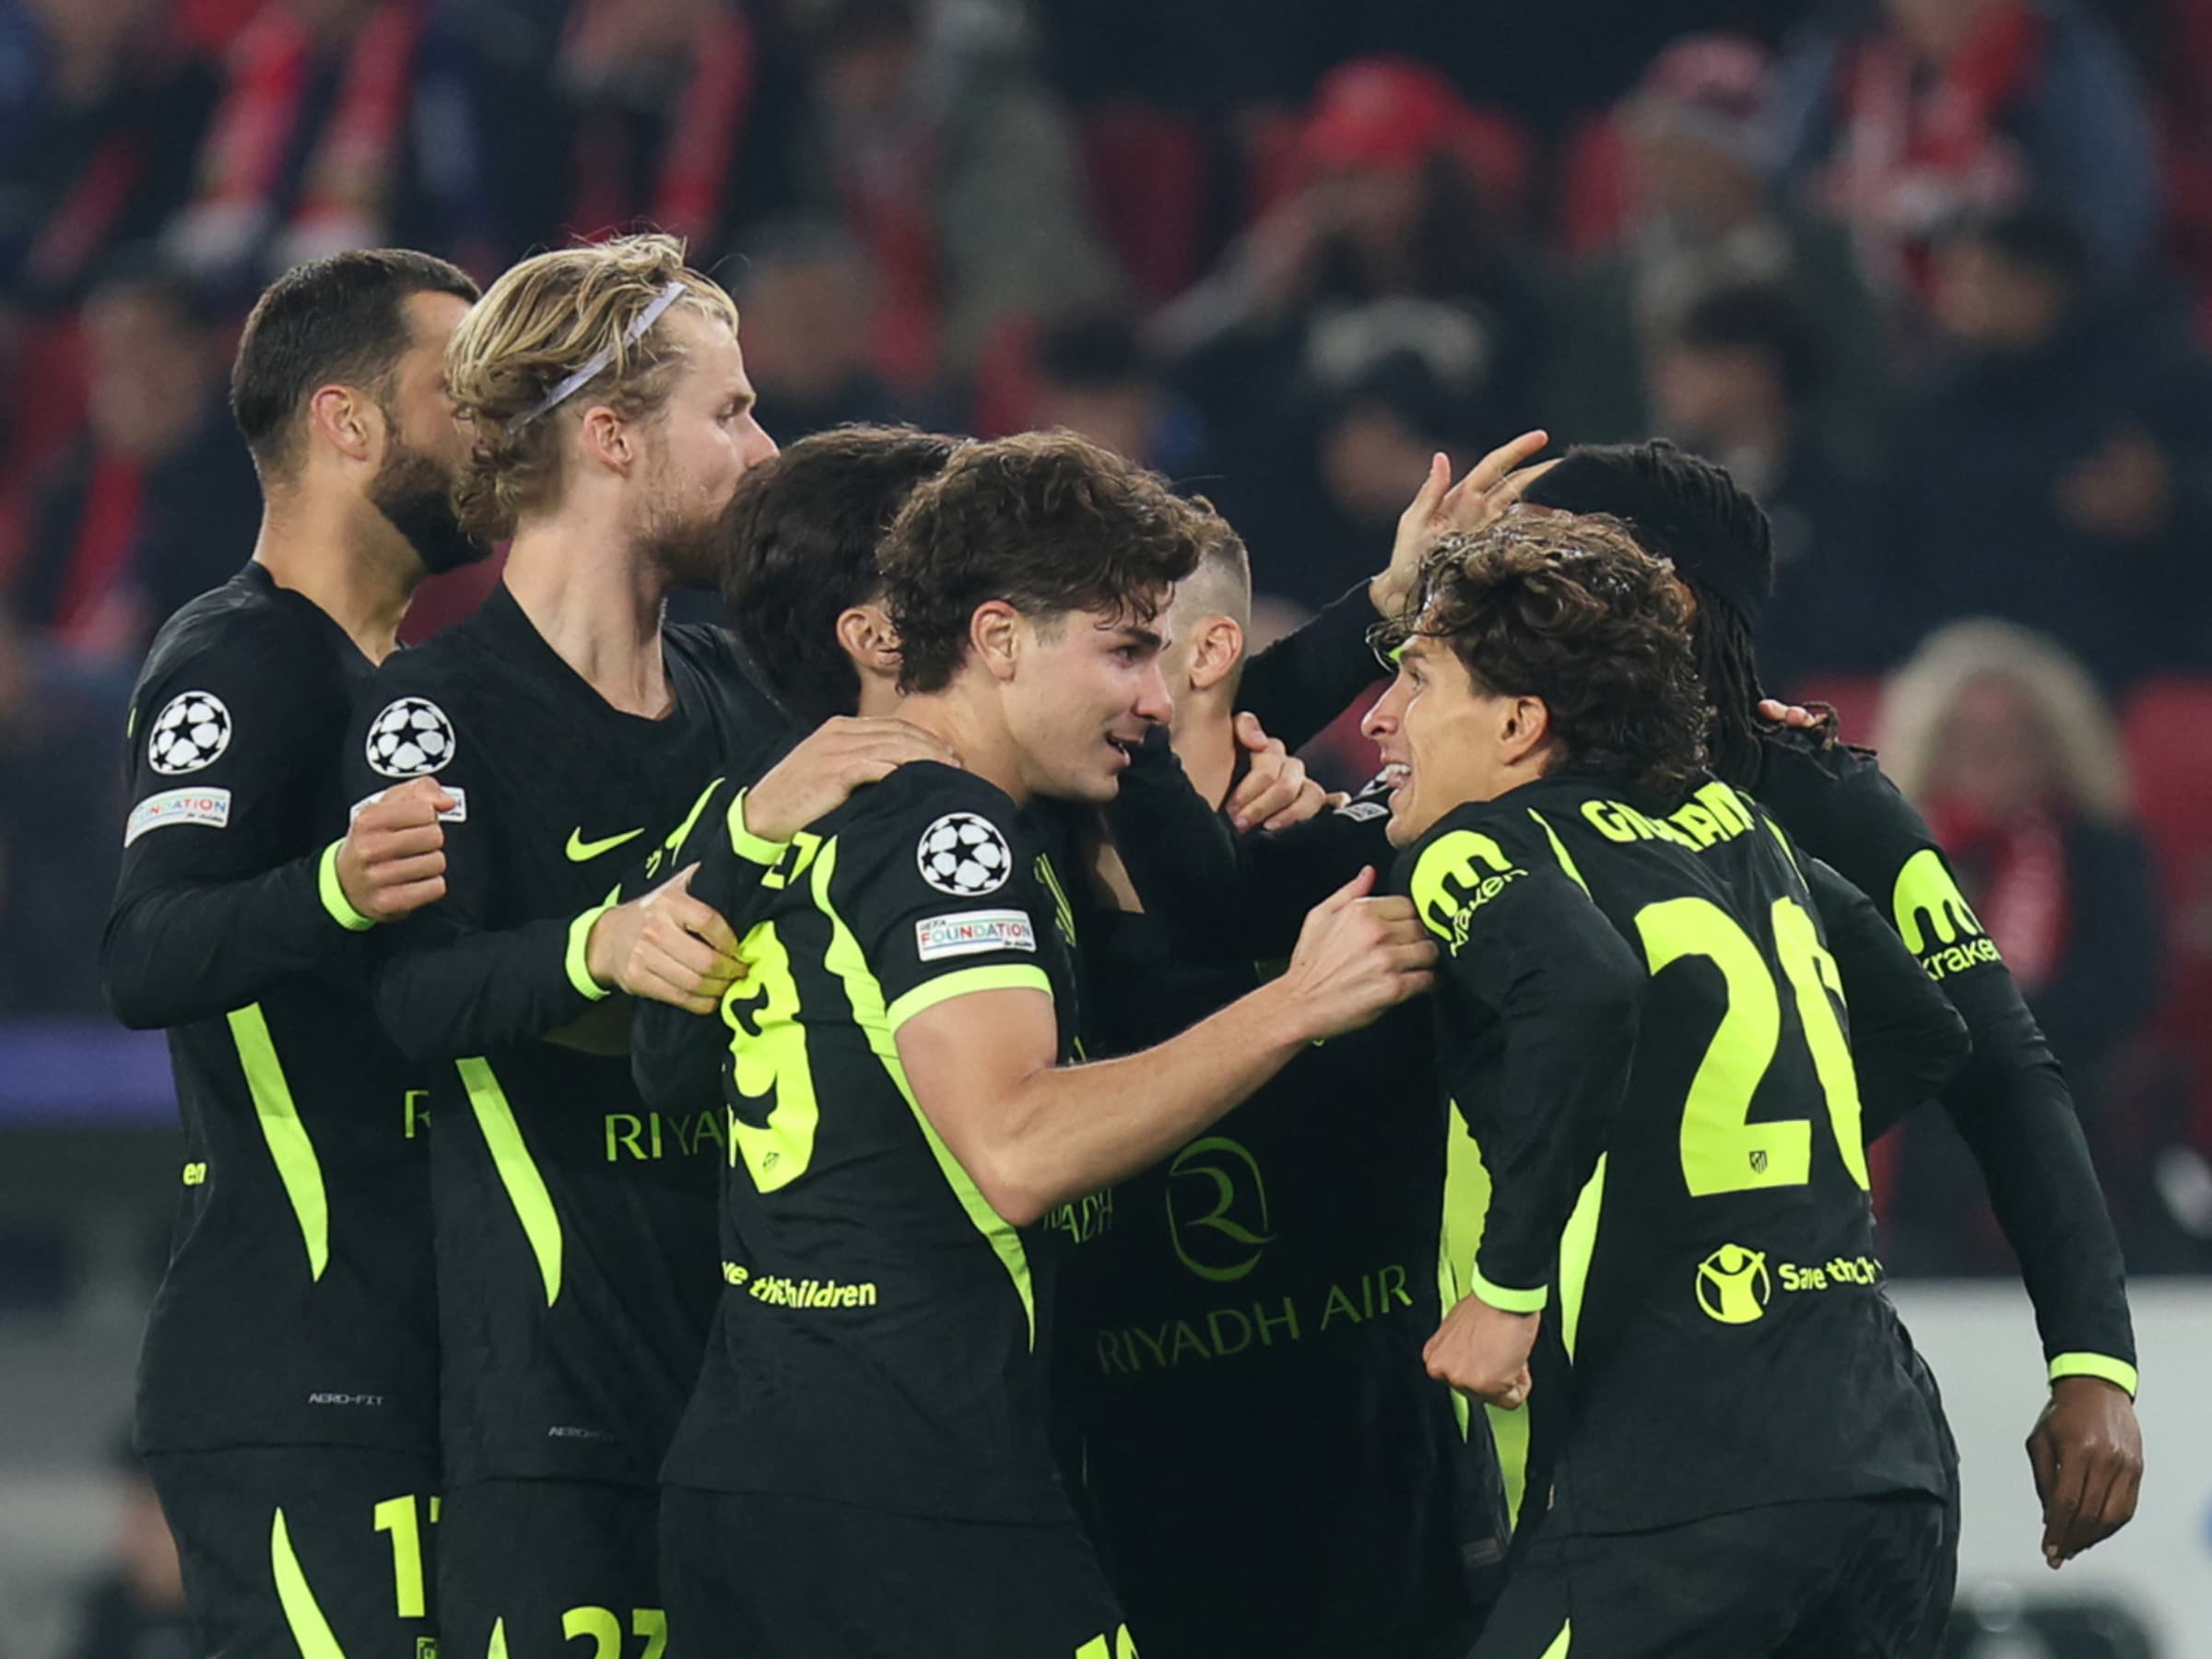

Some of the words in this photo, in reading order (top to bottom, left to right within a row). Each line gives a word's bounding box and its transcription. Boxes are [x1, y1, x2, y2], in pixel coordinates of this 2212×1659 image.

[921, 923, 1031, 947] FOUNDATION
[1096, 1296, 1300, 1375] RIYADH
[1320, 1265, 1413, 1332] AIR
